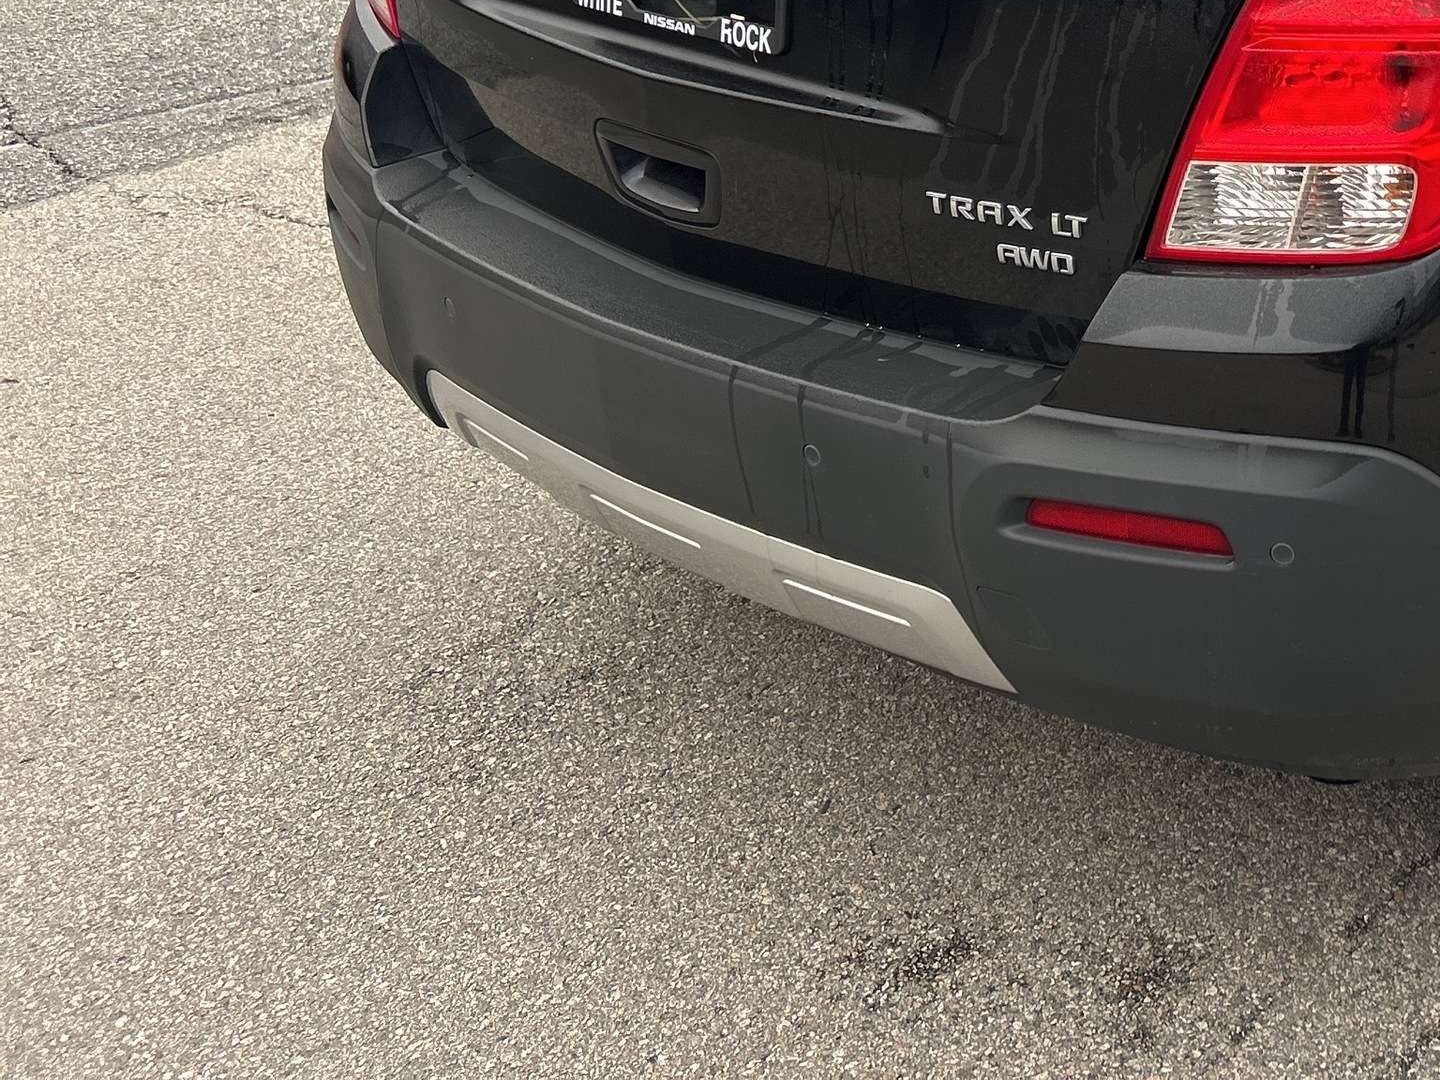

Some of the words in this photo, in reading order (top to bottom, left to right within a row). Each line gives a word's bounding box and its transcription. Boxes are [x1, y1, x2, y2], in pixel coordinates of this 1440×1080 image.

[643, 12, 696, 36] NISSAN
[720, 17, 773, 55] ROCK
[925, 191, 1034, 231] TRAX
[1051, 212, 1089, 239] LT
[996, 243, 1076, 275] AWD
